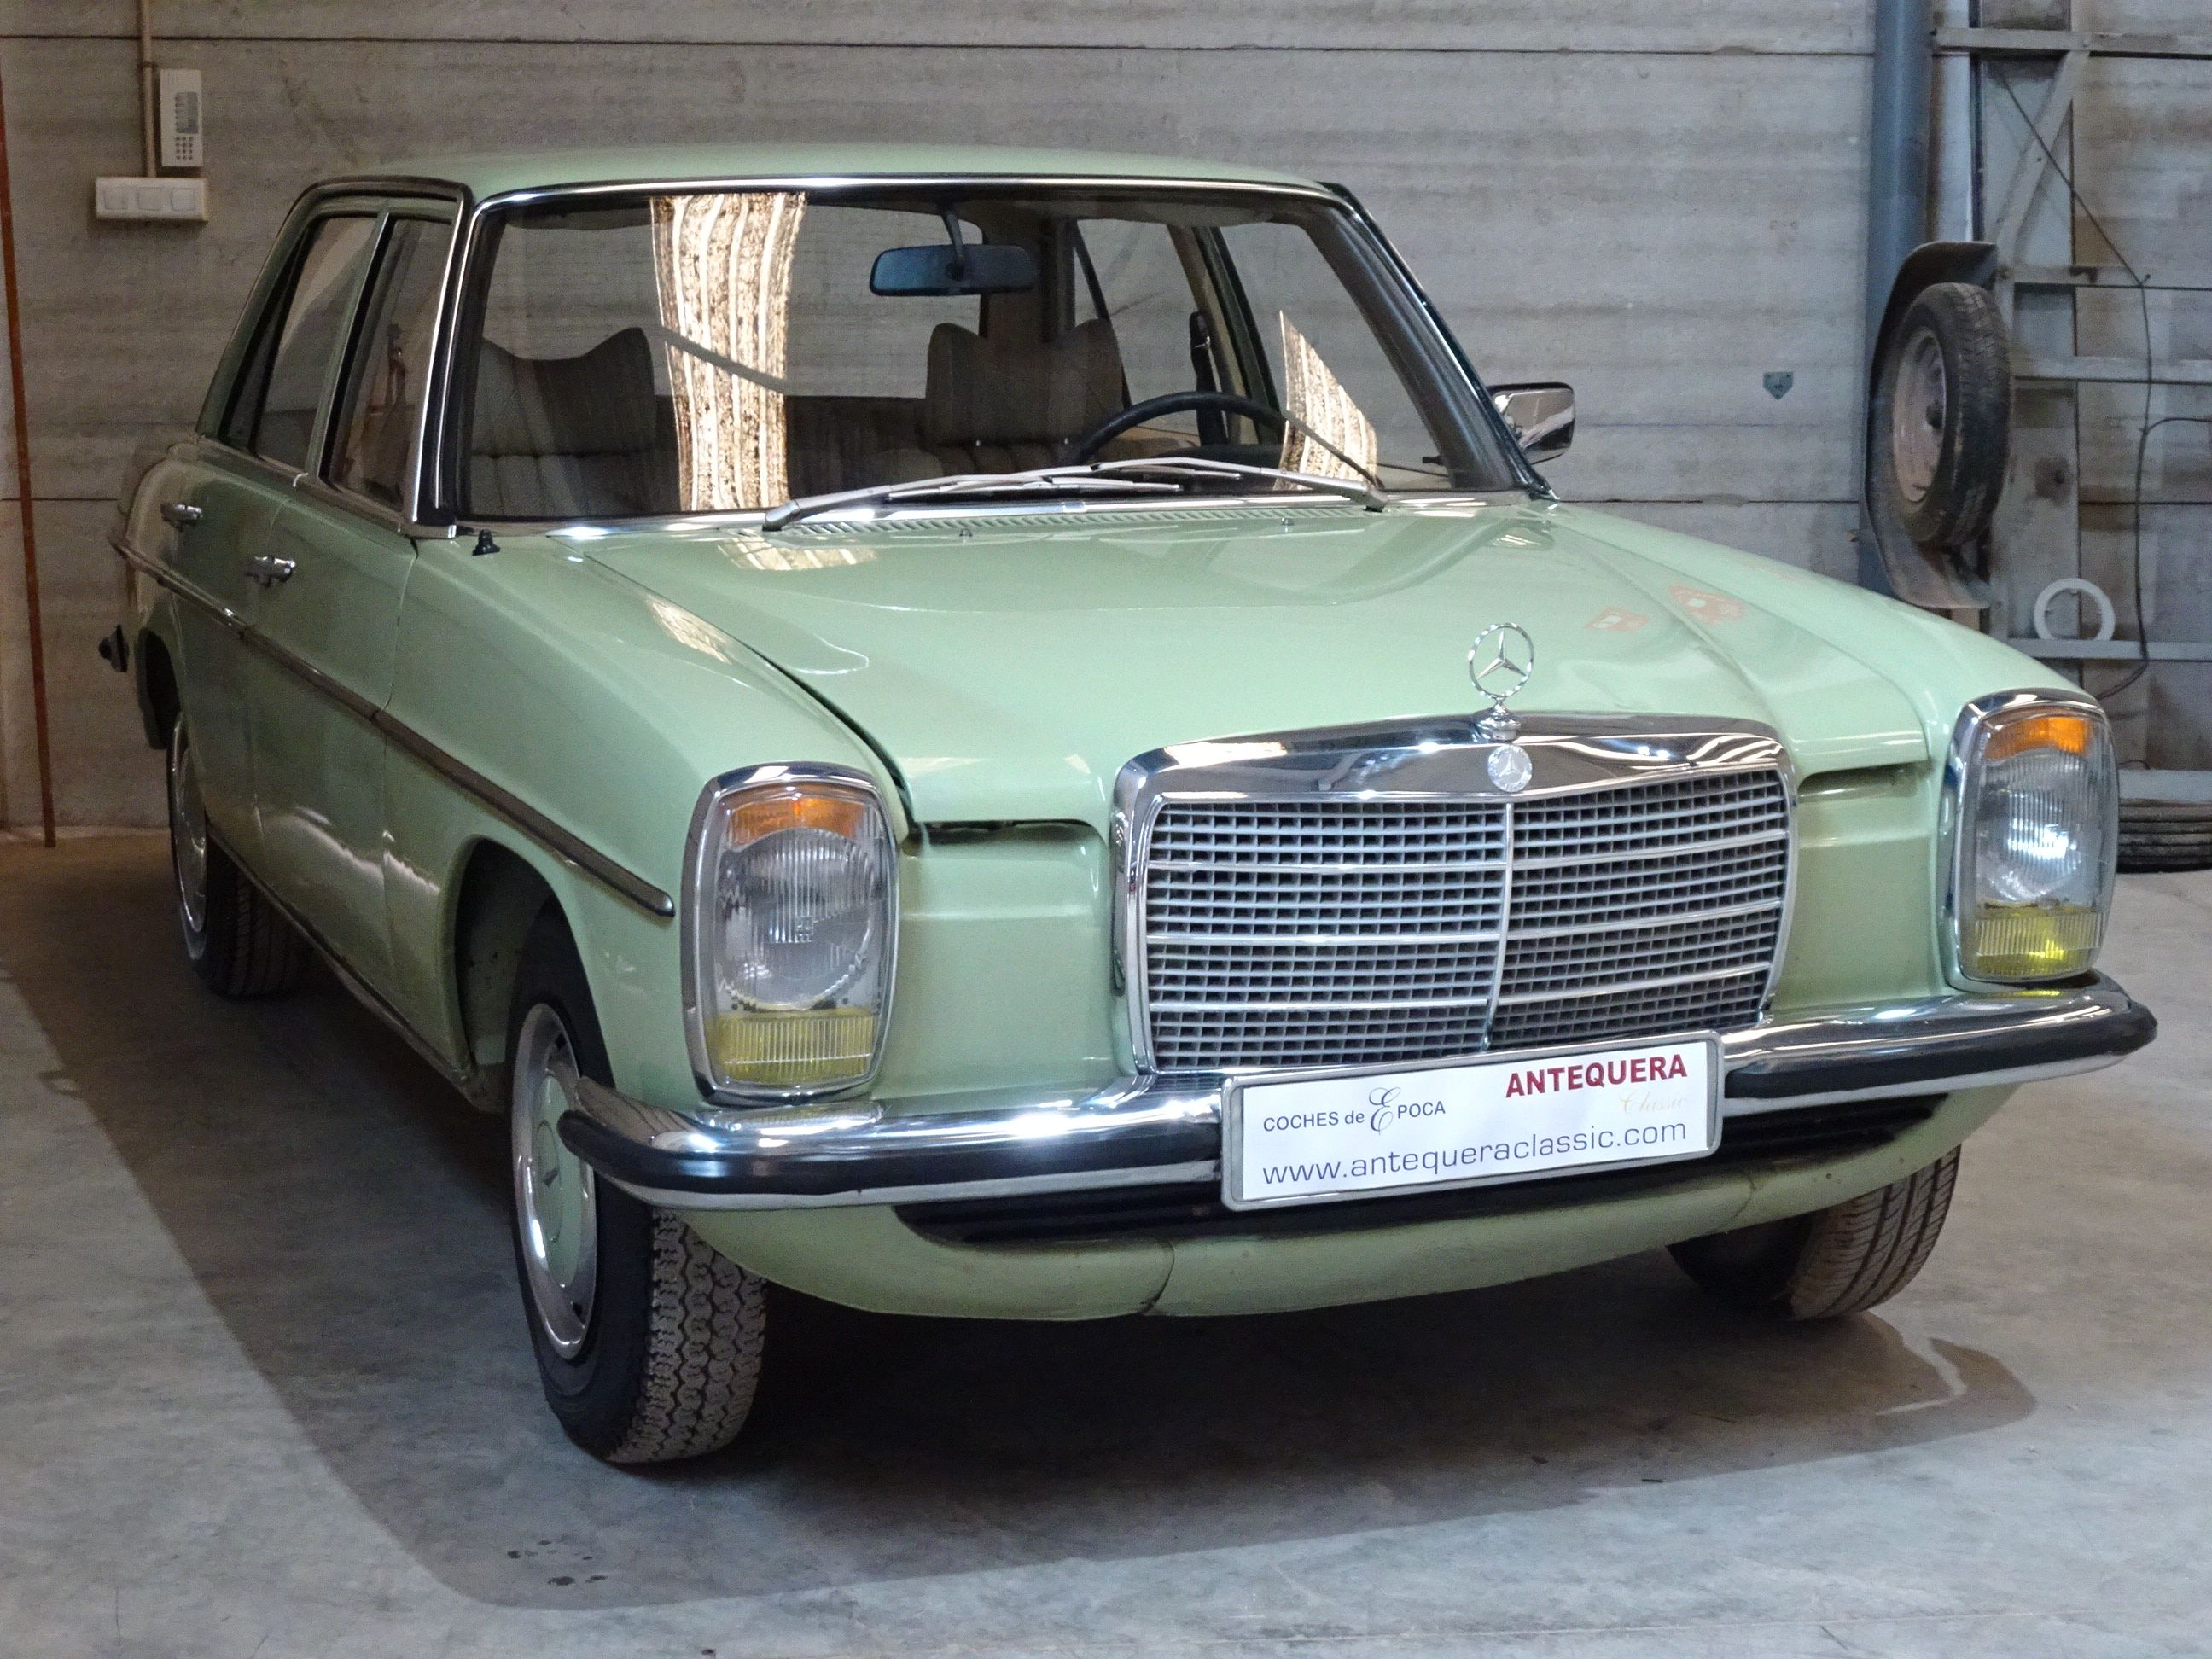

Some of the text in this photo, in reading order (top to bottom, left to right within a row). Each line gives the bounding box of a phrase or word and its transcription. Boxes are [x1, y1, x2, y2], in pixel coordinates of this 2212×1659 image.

[1505, 1054, 1687, 1098] ANTEQUERA
[1620, 1089, 1687, 1115] Classic
[1263, 1111, 1339, 1132] COCHES
[1345, 1109, 1365, 1125] de
[1262, 1120, 1687, 1185] www.antequeraclassic.com
